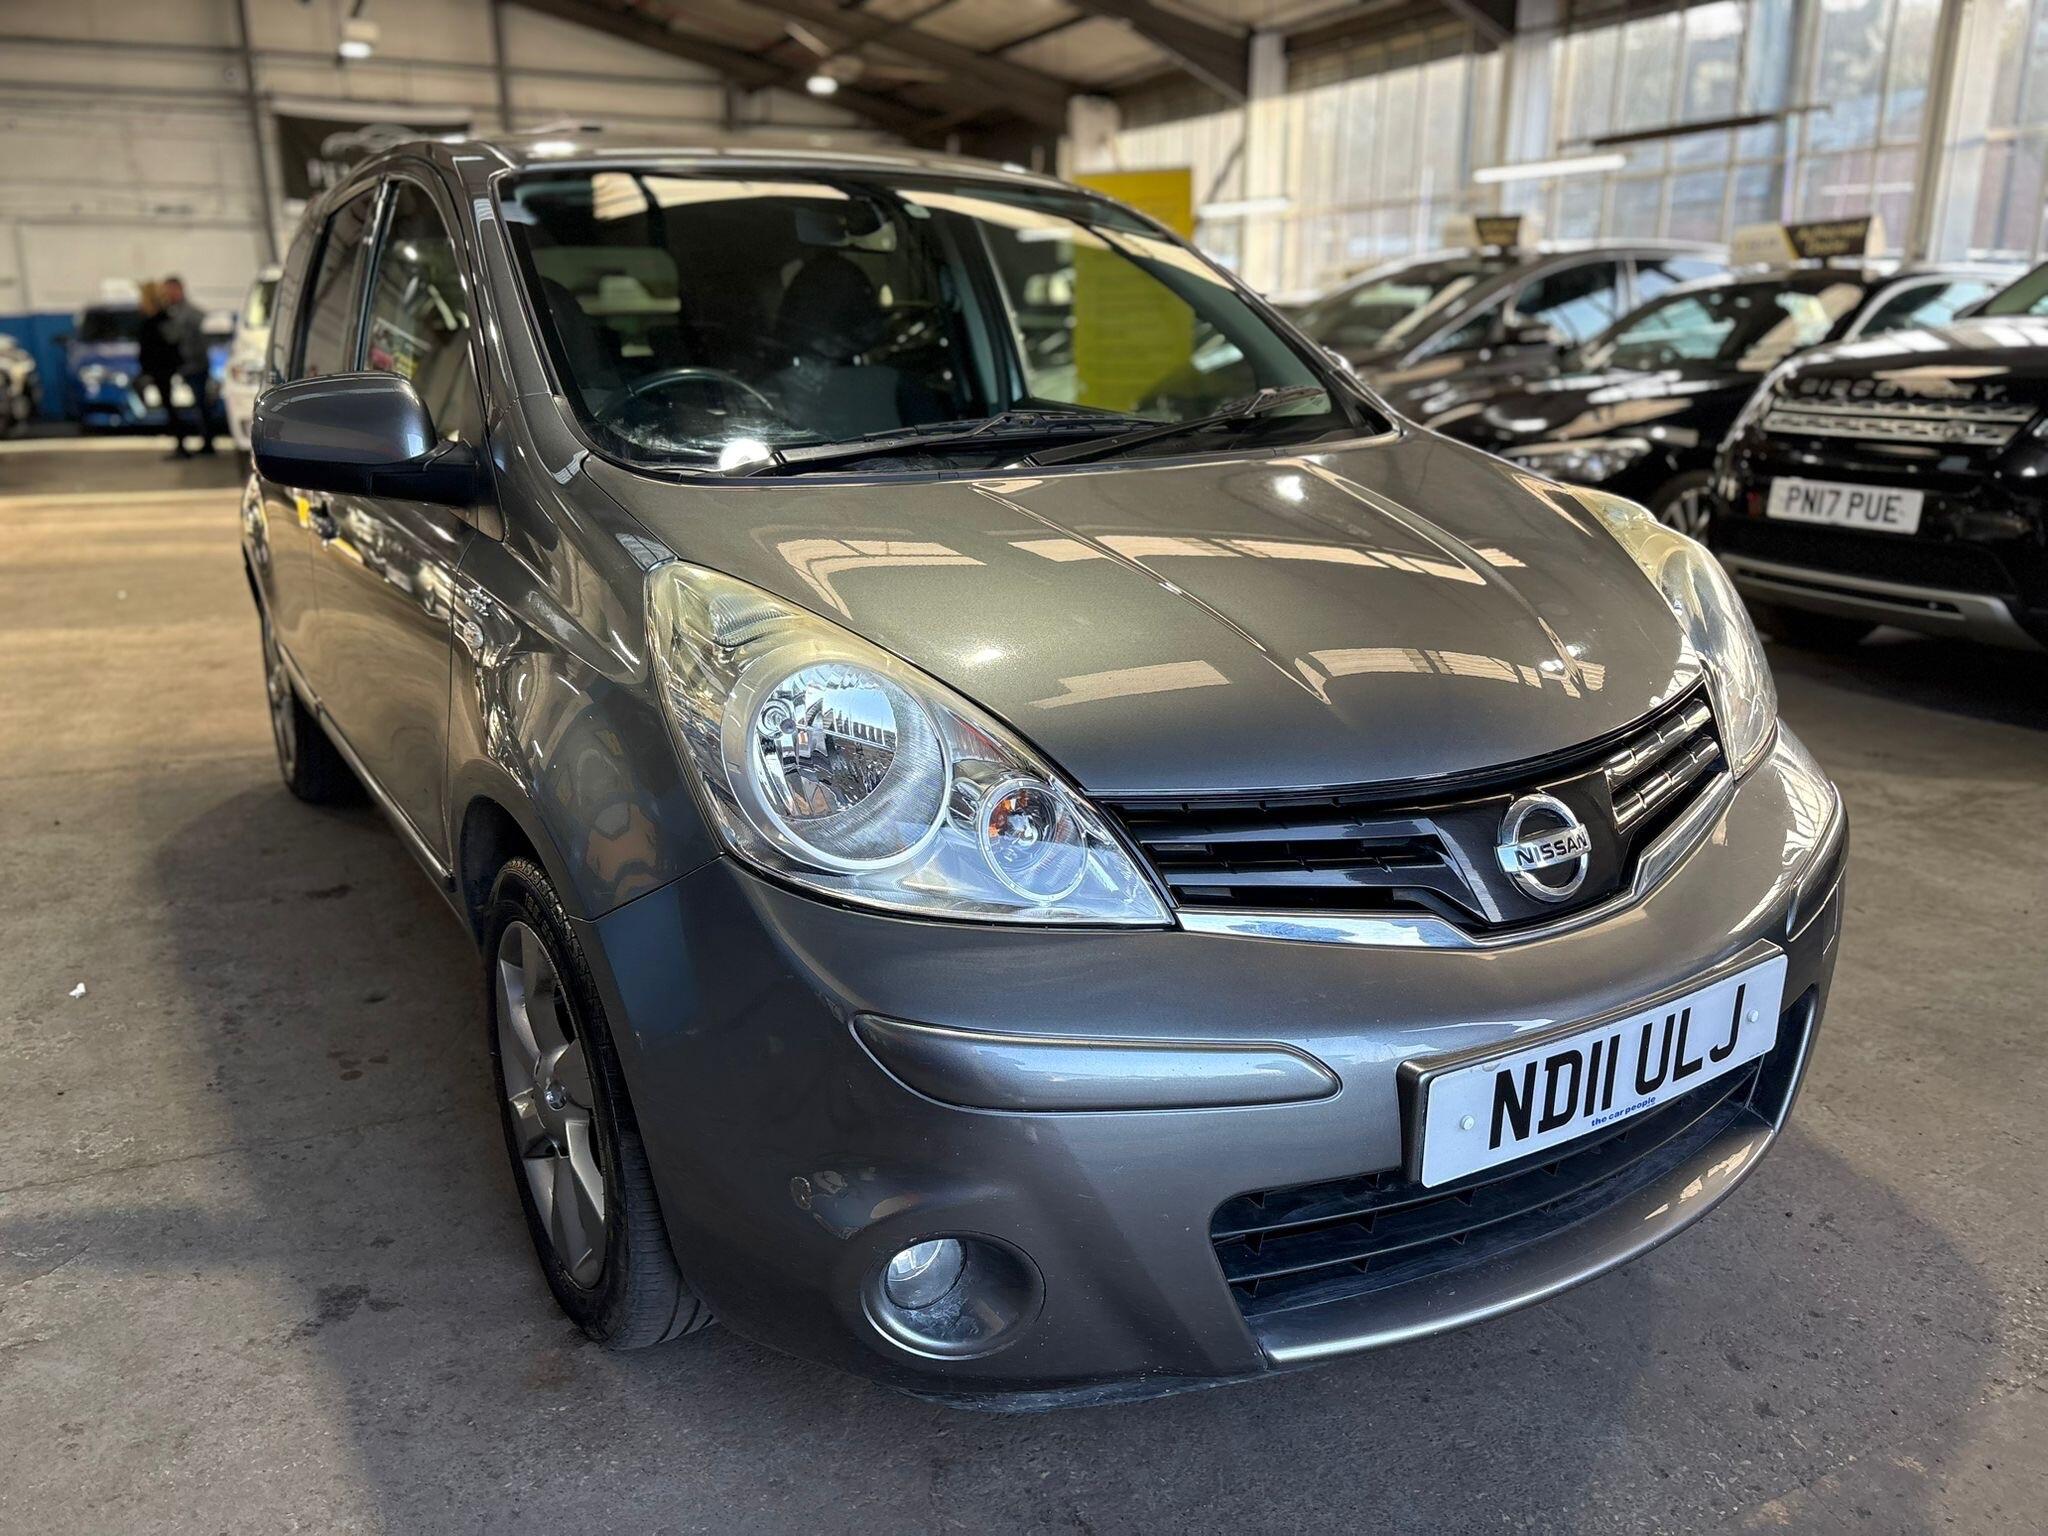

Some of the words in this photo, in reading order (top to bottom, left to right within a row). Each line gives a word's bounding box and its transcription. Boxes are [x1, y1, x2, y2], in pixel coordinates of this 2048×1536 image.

[1785, 485, 1841, 517] PN17
[1846, 492, 1901, 524] PUE
[1514, 831, 1588, 866] NISSAN
[1489, 1033, 1621, 1150] ND11
[1634, 983, 1747, 1096] ULJ
[1591, 1117, 1608, 1127] the
[1608, 1110, 1625, 1120] car
[1624, 1096, 1656, 1115] people
